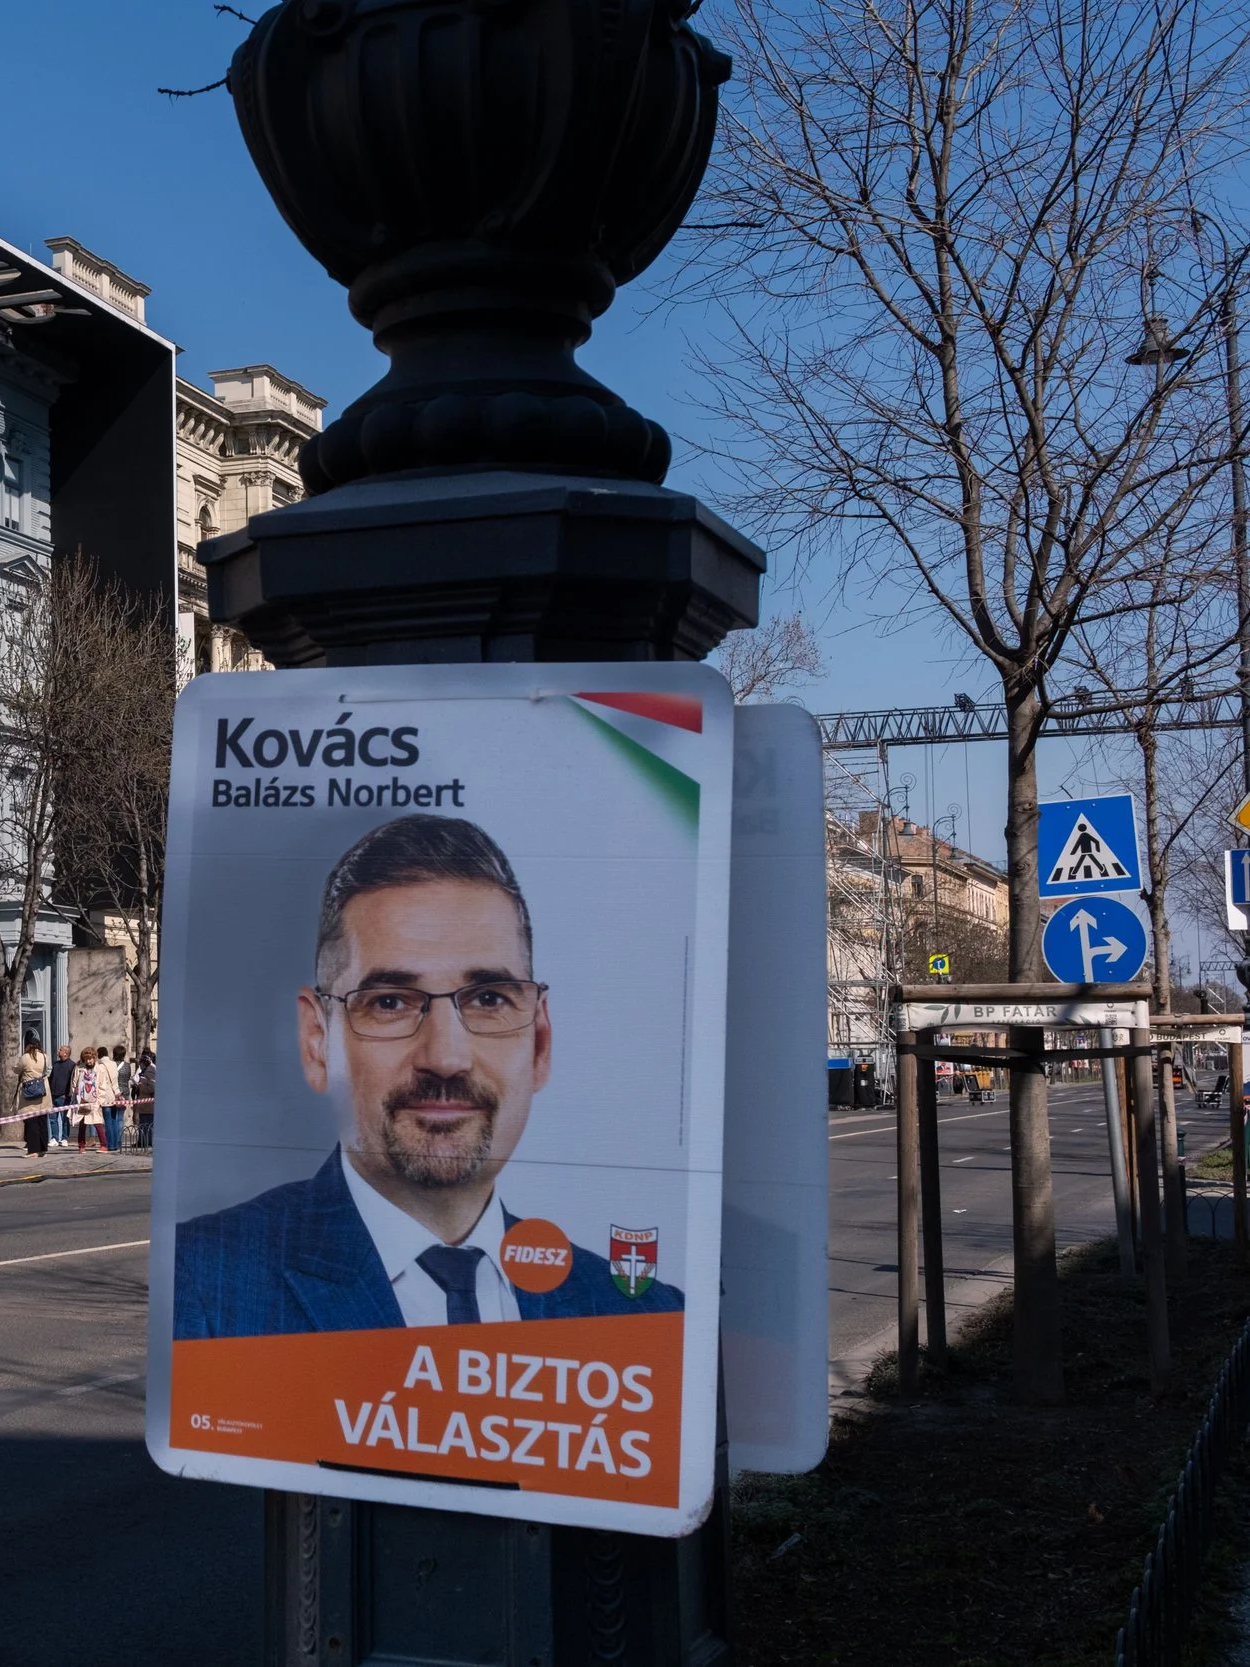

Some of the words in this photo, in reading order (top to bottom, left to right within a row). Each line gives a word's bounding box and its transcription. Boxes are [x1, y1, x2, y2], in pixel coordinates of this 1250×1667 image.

[214, 711, 421, 769] Kovács
[212, 777, 315, 808] Balázs
[327, 777, 466, 809] Norbert
[973, 1006, 996, 1018] BP
[1156, 1032, 1206, 1041] BUDAPEST
[613, 1229, 654, 1242] KDNP
[504, 1244, 568, 1267] FIDESZ
[403, 1345, 443, 1391] A
[457, 1348, 654, 1413] BIZTOS
[190, 1412, 214, 1431] 05.
[334, 1391, 652, 1478] VÁLASZTÁS
